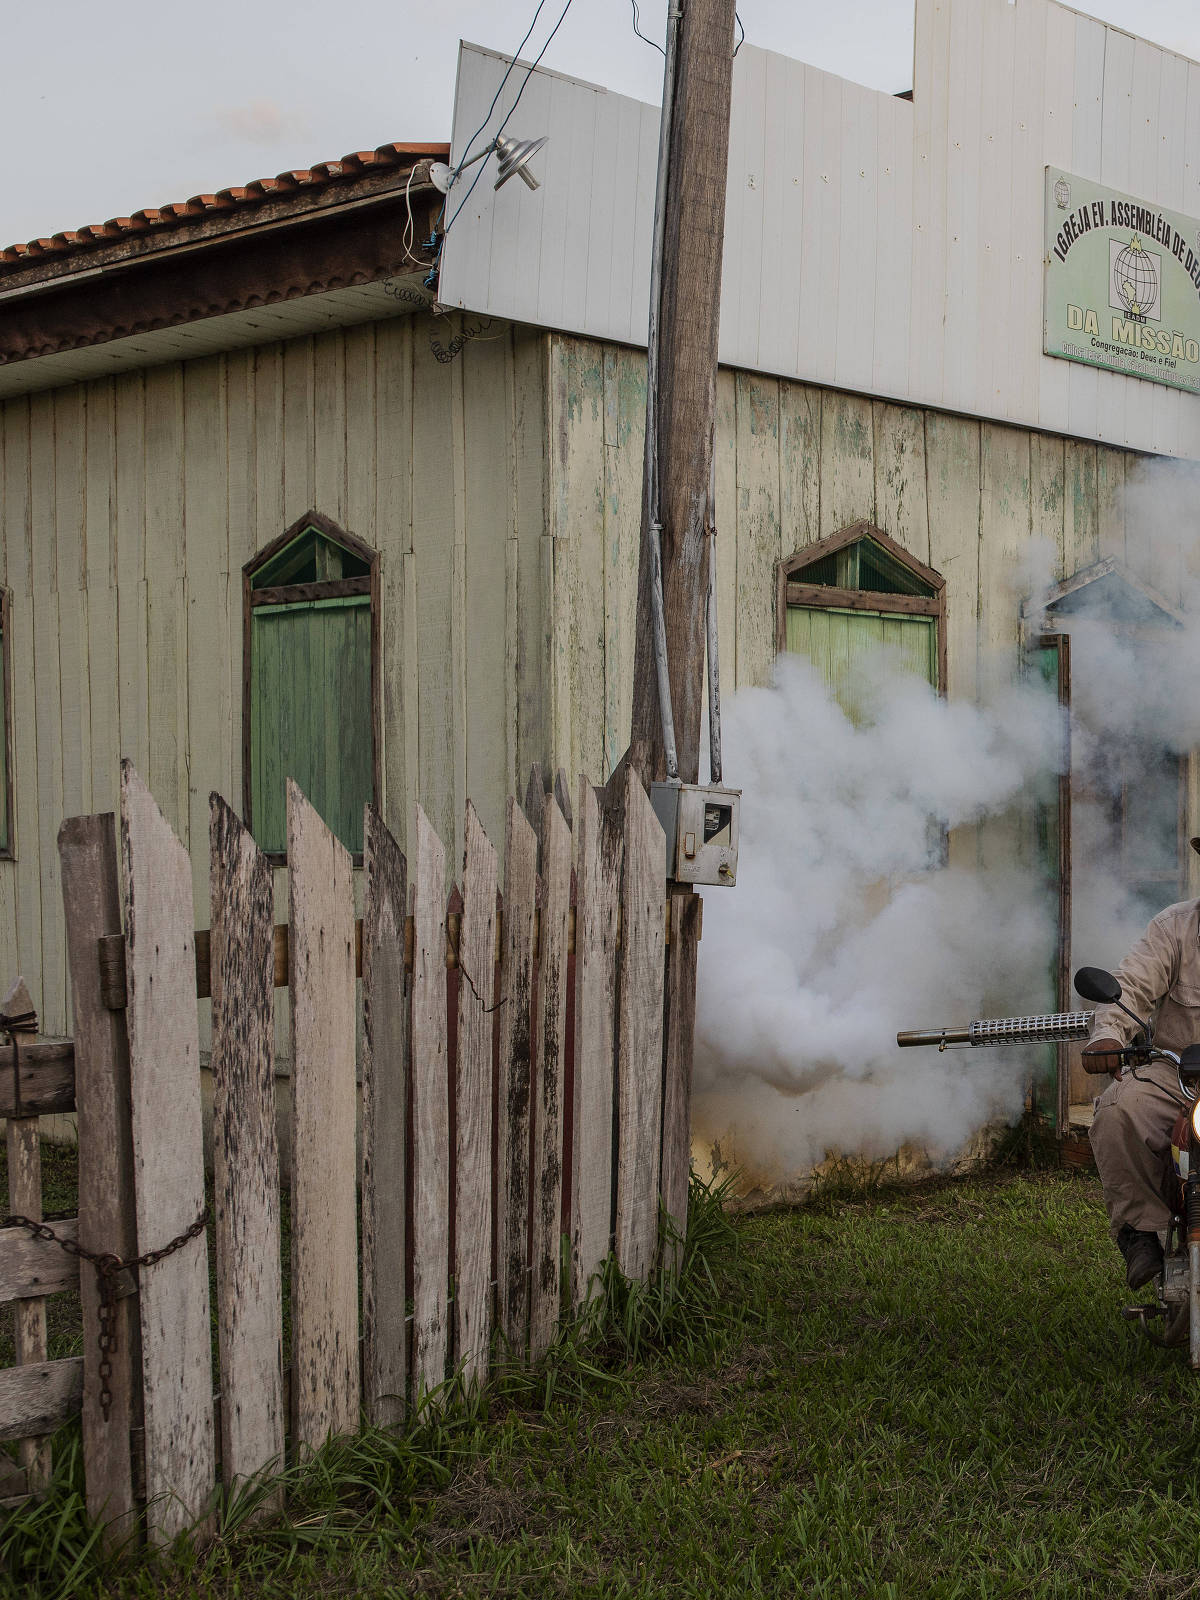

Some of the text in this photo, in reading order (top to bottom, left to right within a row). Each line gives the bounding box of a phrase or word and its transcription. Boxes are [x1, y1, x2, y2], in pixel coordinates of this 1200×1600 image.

[1054, 206, 1091, 263] IGREJA
[1092, 201, 1108, 228] EV.
[1111, 201, 1171, 249] ASSEMBLÉIA
[1172, 231, 1186, 263] DE
[1067, 303, 1199, 363] DA MISSÃO
[1124, 311, 1146, 323] IEADM
[1090, 338, 1177, 368] Congregação: Deus e Fiel
